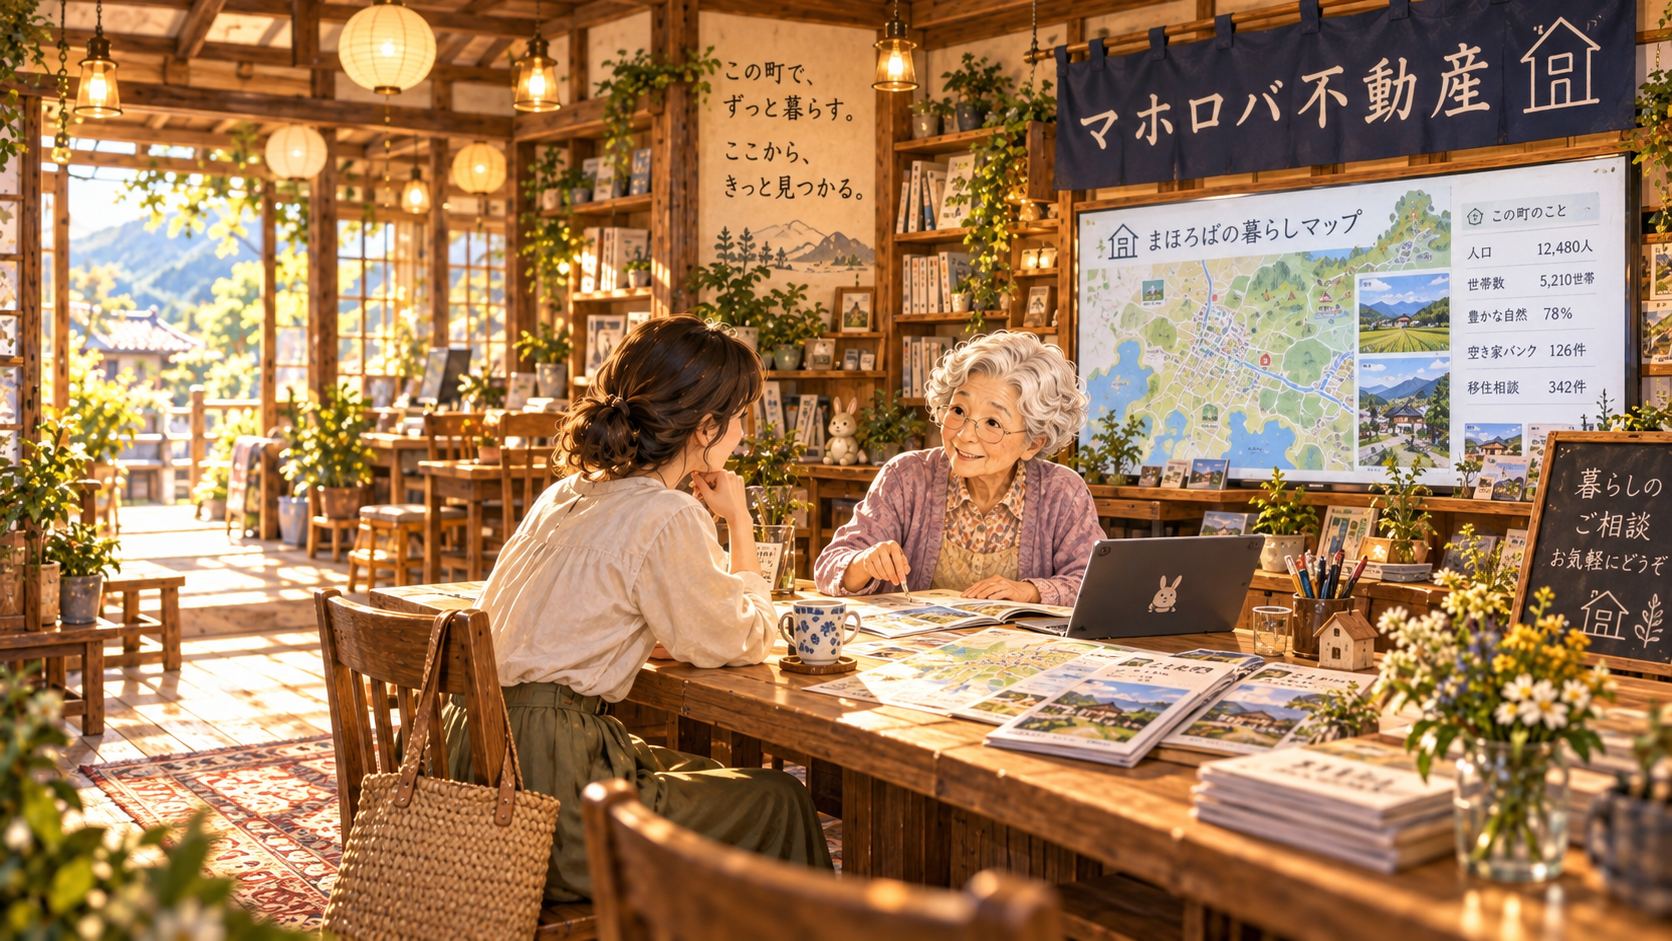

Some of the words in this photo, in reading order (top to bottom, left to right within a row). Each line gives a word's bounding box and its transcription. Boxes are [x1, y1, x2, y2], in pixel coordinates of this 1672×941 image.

[725, 61, 813, 86] この町で、
[723, 94, 853, 121] ずっと暮らす。
[1079, 42, 1491, 151] マホロバ不動産
[725, 141, 809, 165] ここから、
[724, 174, 863, 200] きっと見つかる。
[1492, 204, 1567, 222] この町のこと
[1148, 208, 1363, 252] まほろばの暮らしマップ
[1467, 246, 1492, 260] 人口
[1537, 239, 1593, 256] 12,480人
[1467, 276, 1505, 291] 世帯数
[1540, 271, 1595, 289] 5,210世帯
[1467, 308, 1528, 324] 豊かな自然
[1543, 307, 1573, 320] 78%
[1467, 344, 1537, 360] 空き家バンク
[1550, 342, 1586, 358] 126件
[1467, 380, 1520, 395] 移住相談
[1549, 379, 1587, 394] 342件
[1574, 467, 1663, 500] 暮らしの
[1575, 510, 1651, 541] ご相談
[1550, 548, 1669, 576] お気軽にどうぞ
